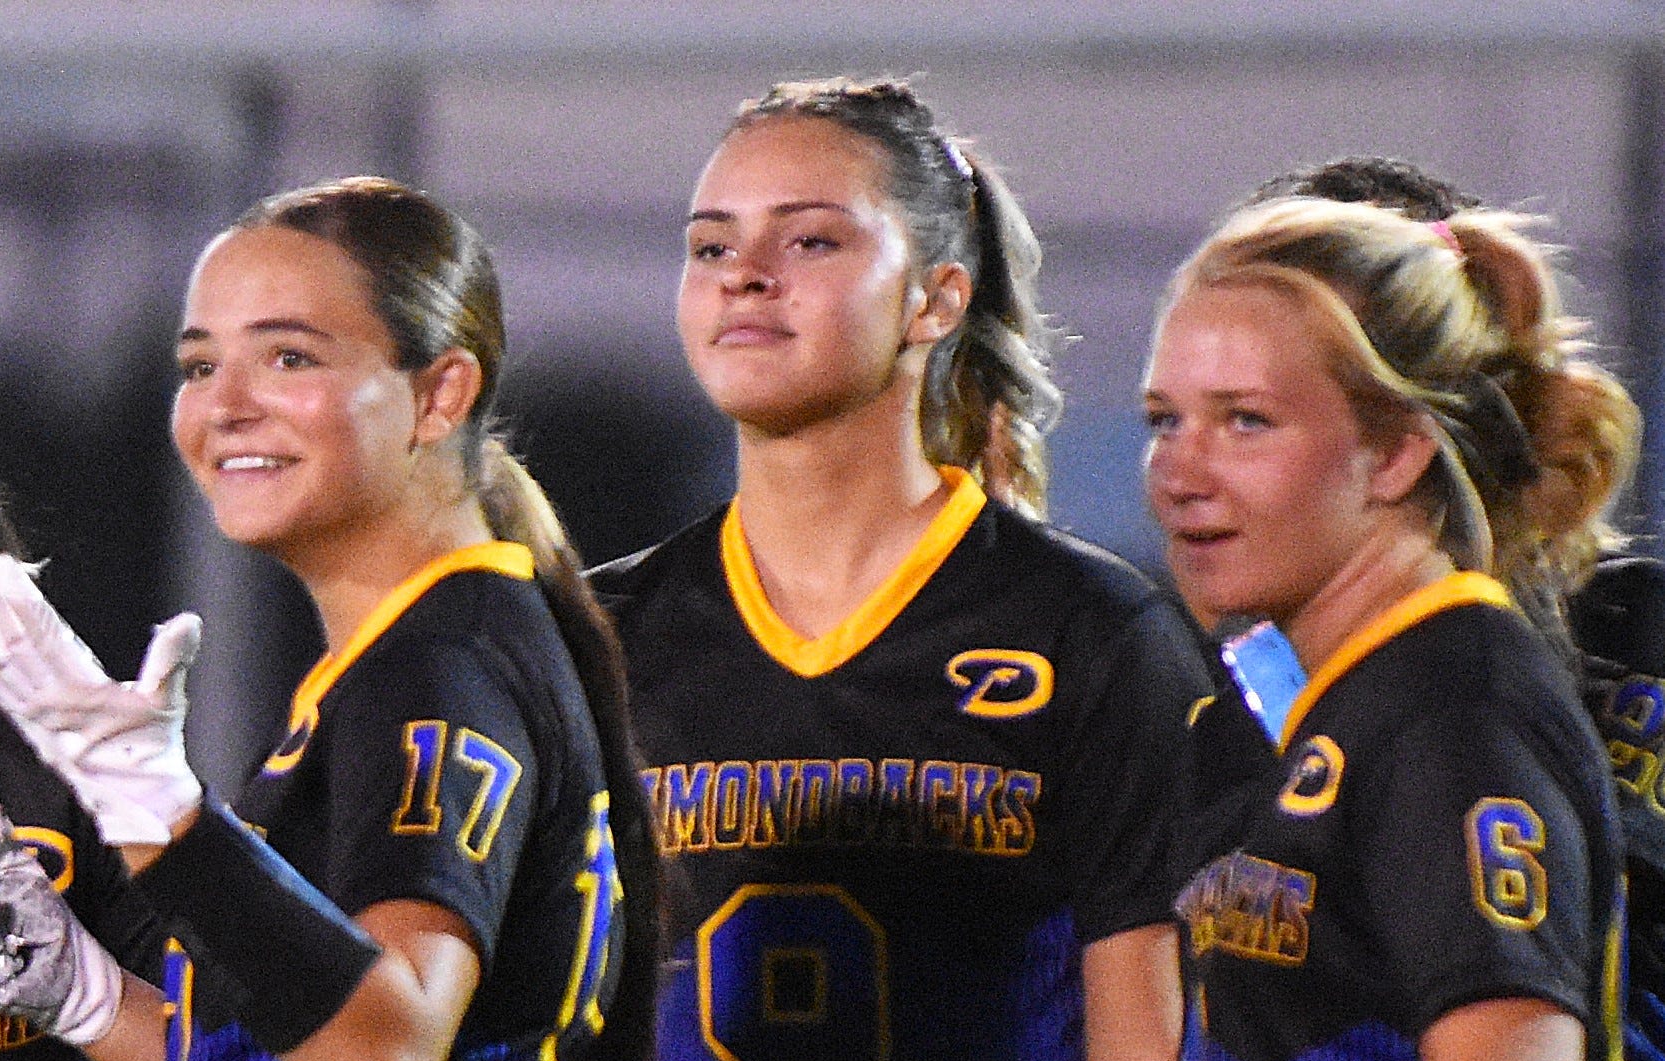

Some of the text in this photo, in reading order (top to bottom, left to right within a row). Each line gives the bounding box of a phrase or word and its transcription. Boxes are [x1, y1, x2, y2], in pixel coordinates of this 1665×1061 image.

[944, 648, 1055, 719] D
[390, 719, 523, 862] 17
[1464, 796, 1548, 931] 6
